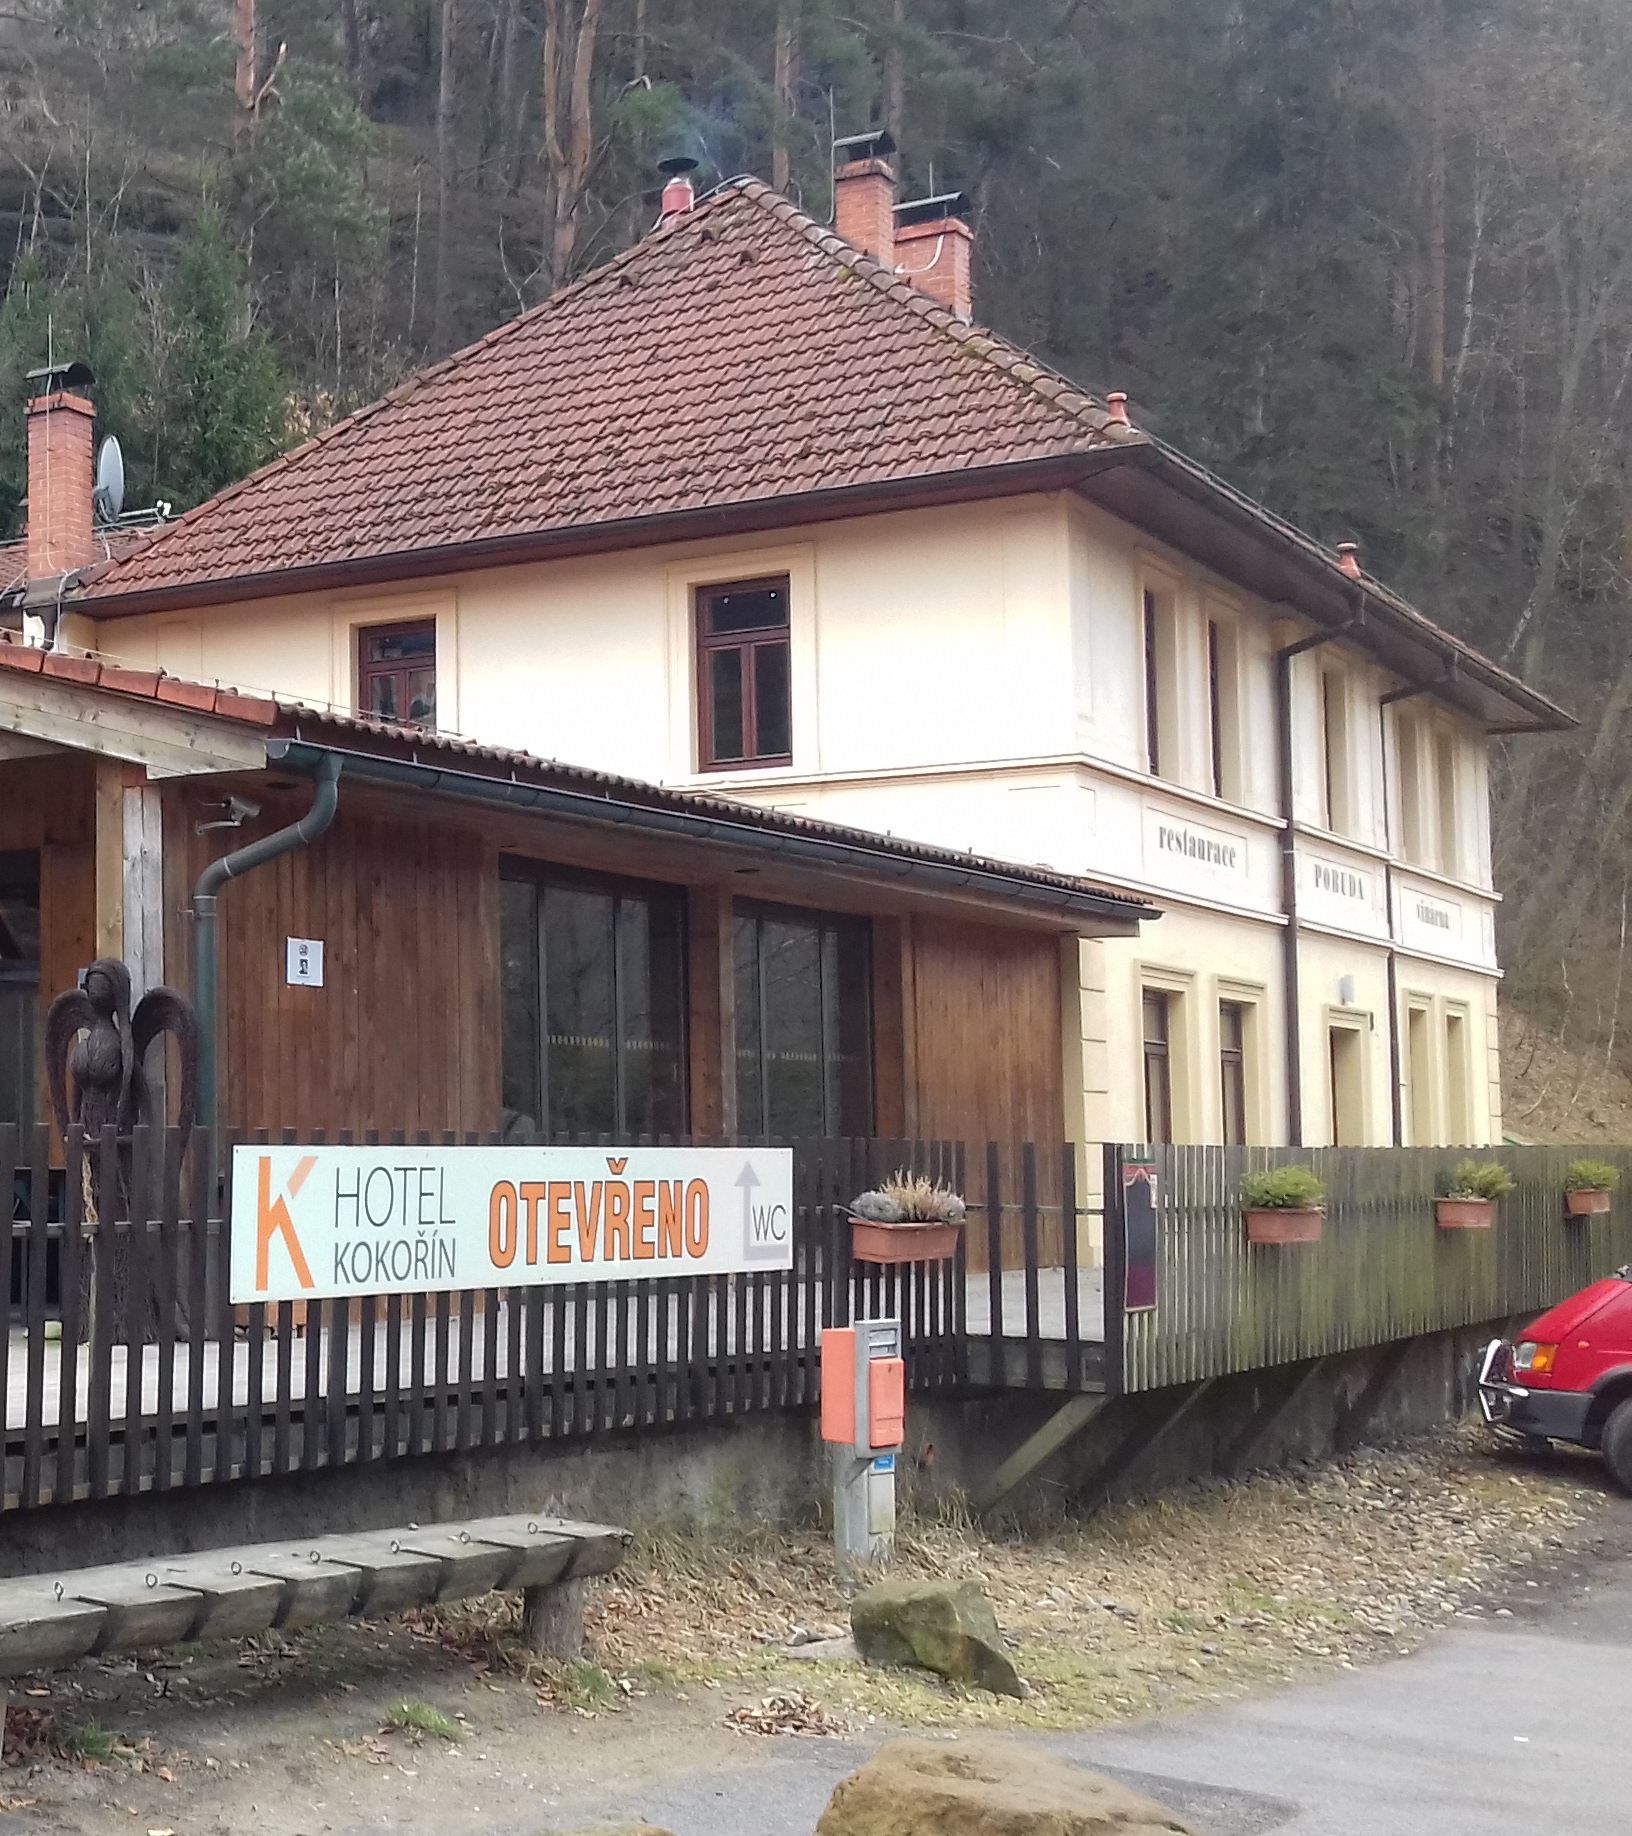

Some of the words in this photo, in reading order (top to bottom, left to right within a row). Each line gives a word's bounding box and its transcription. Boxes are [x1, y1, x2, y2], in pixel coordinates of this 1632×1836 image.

[1158, 825, 1236, 869] restaurace
[334, 1166, 456, 1228] HOTEL
[488, 1156, 709, 1268] OTEVŘENO
[752, 1204, 787, 1241] WC
[334, 1229, 456, 1285] KOKOŘÍN
